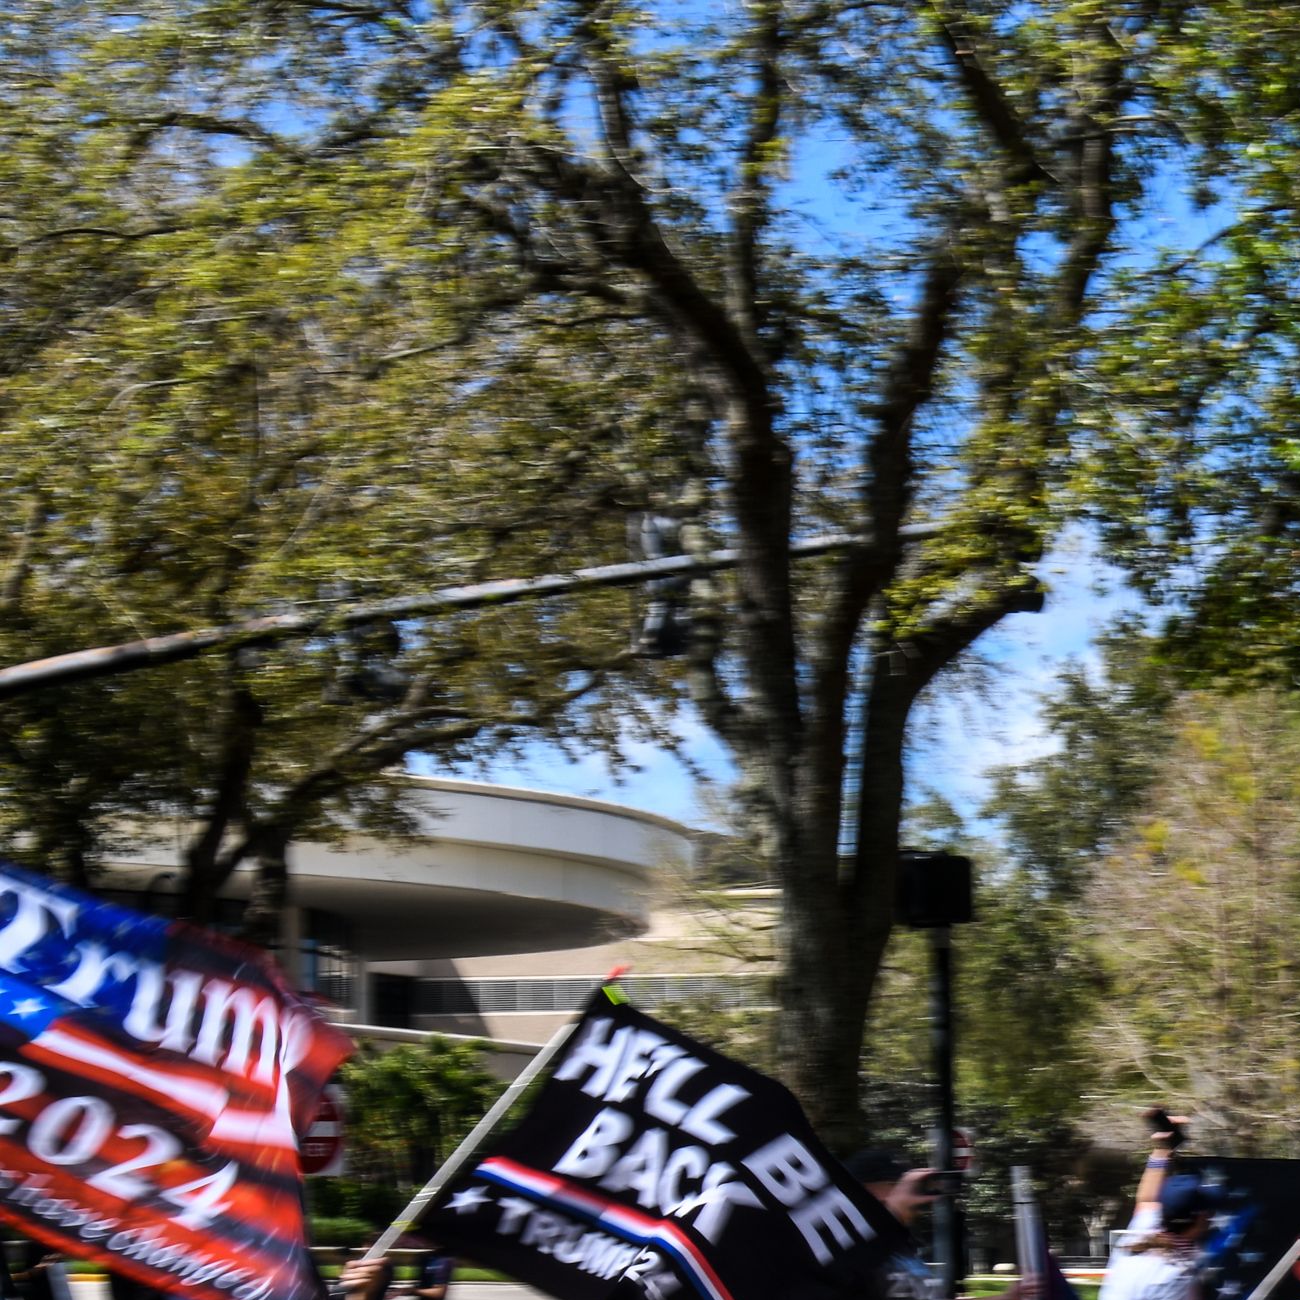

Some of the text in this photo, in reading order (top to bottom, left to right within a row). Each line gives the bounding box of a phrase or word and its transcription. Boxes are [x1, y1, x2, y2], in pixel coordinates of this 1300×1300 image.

[0, 875, 314, 1092] Trump
[0, 1061, 239, 1232] 2024
[553, 1016, 878, 1267] HE'LL BE
[553, 1107, 768, 1247] BACK
